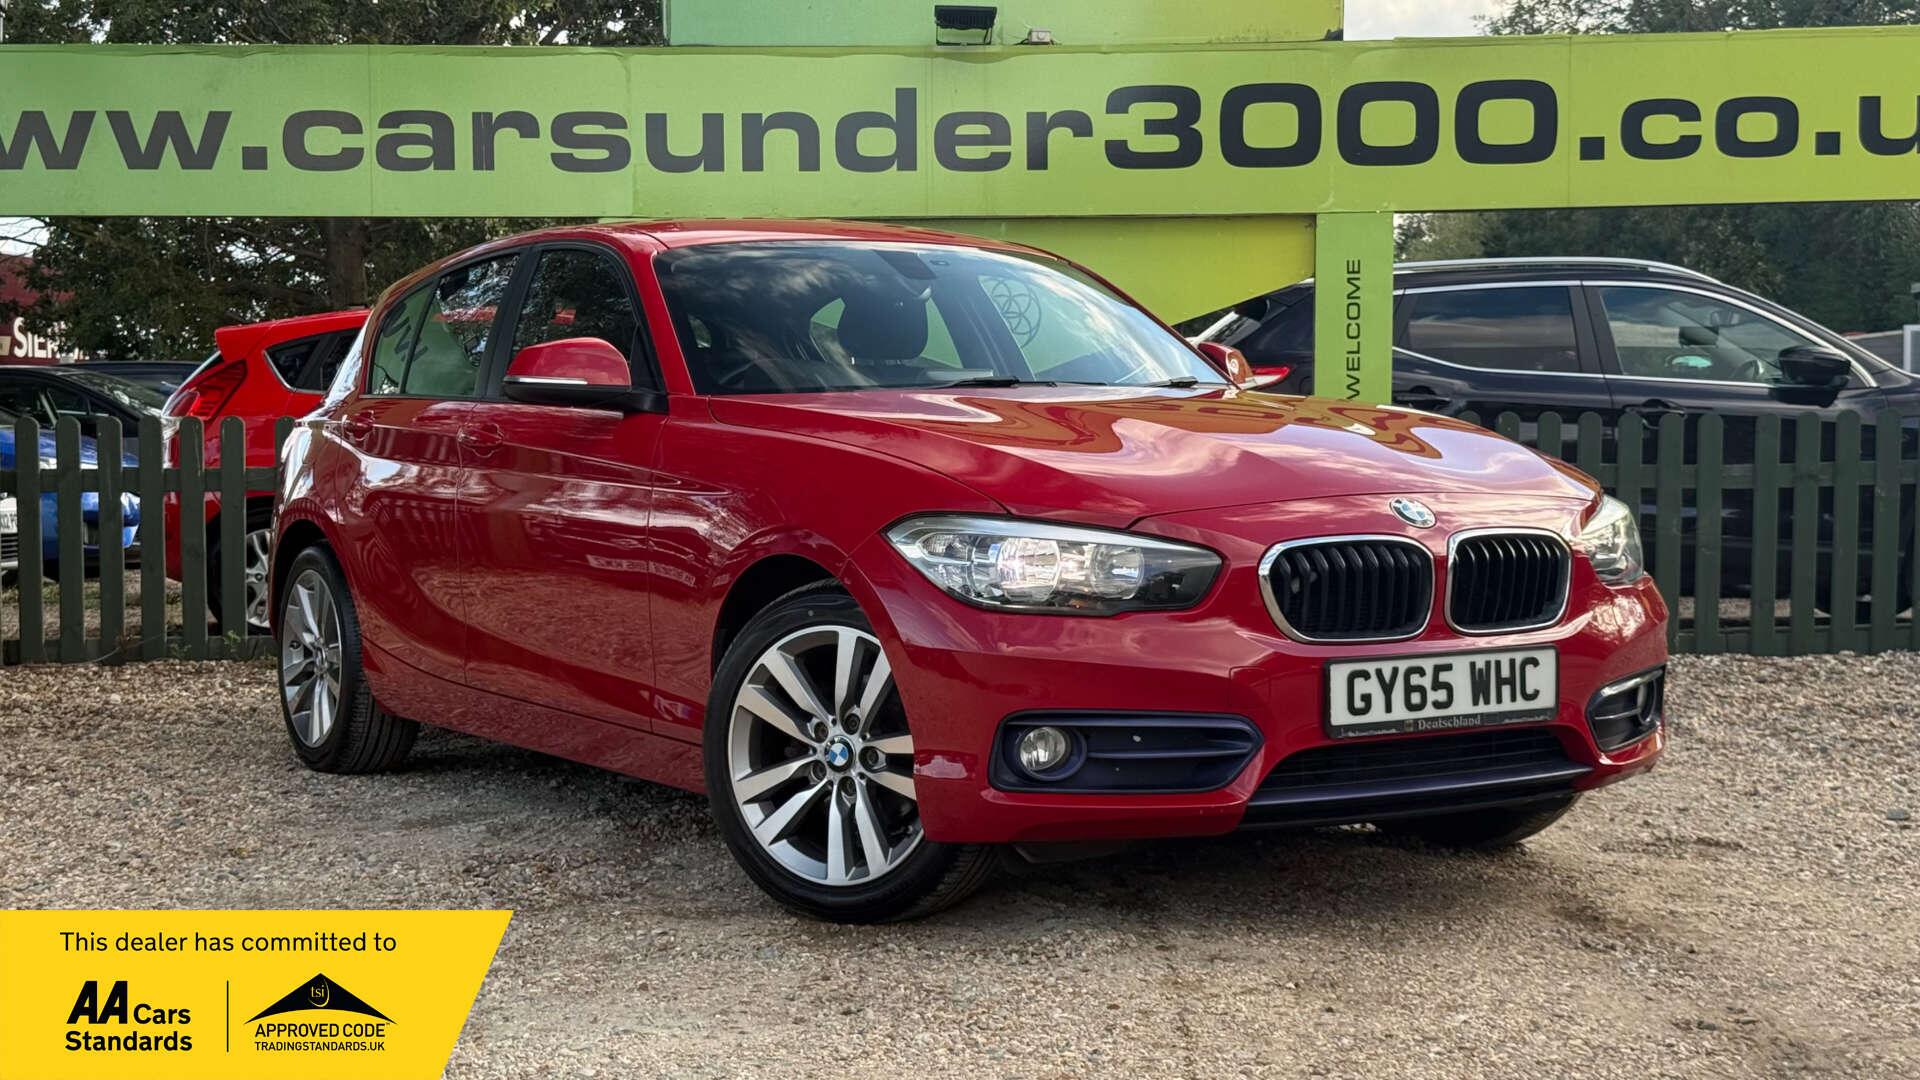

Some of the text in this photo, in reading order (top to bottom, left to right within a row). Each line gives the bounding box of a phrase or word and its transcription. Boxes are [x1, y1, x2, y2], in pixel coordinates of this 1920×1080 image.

[1346, 259, 1361, 400] WELCOME
[1346, 656, 1541, 716] GY65 WHC
[1418, 714, 1481, 730] Deutschland
